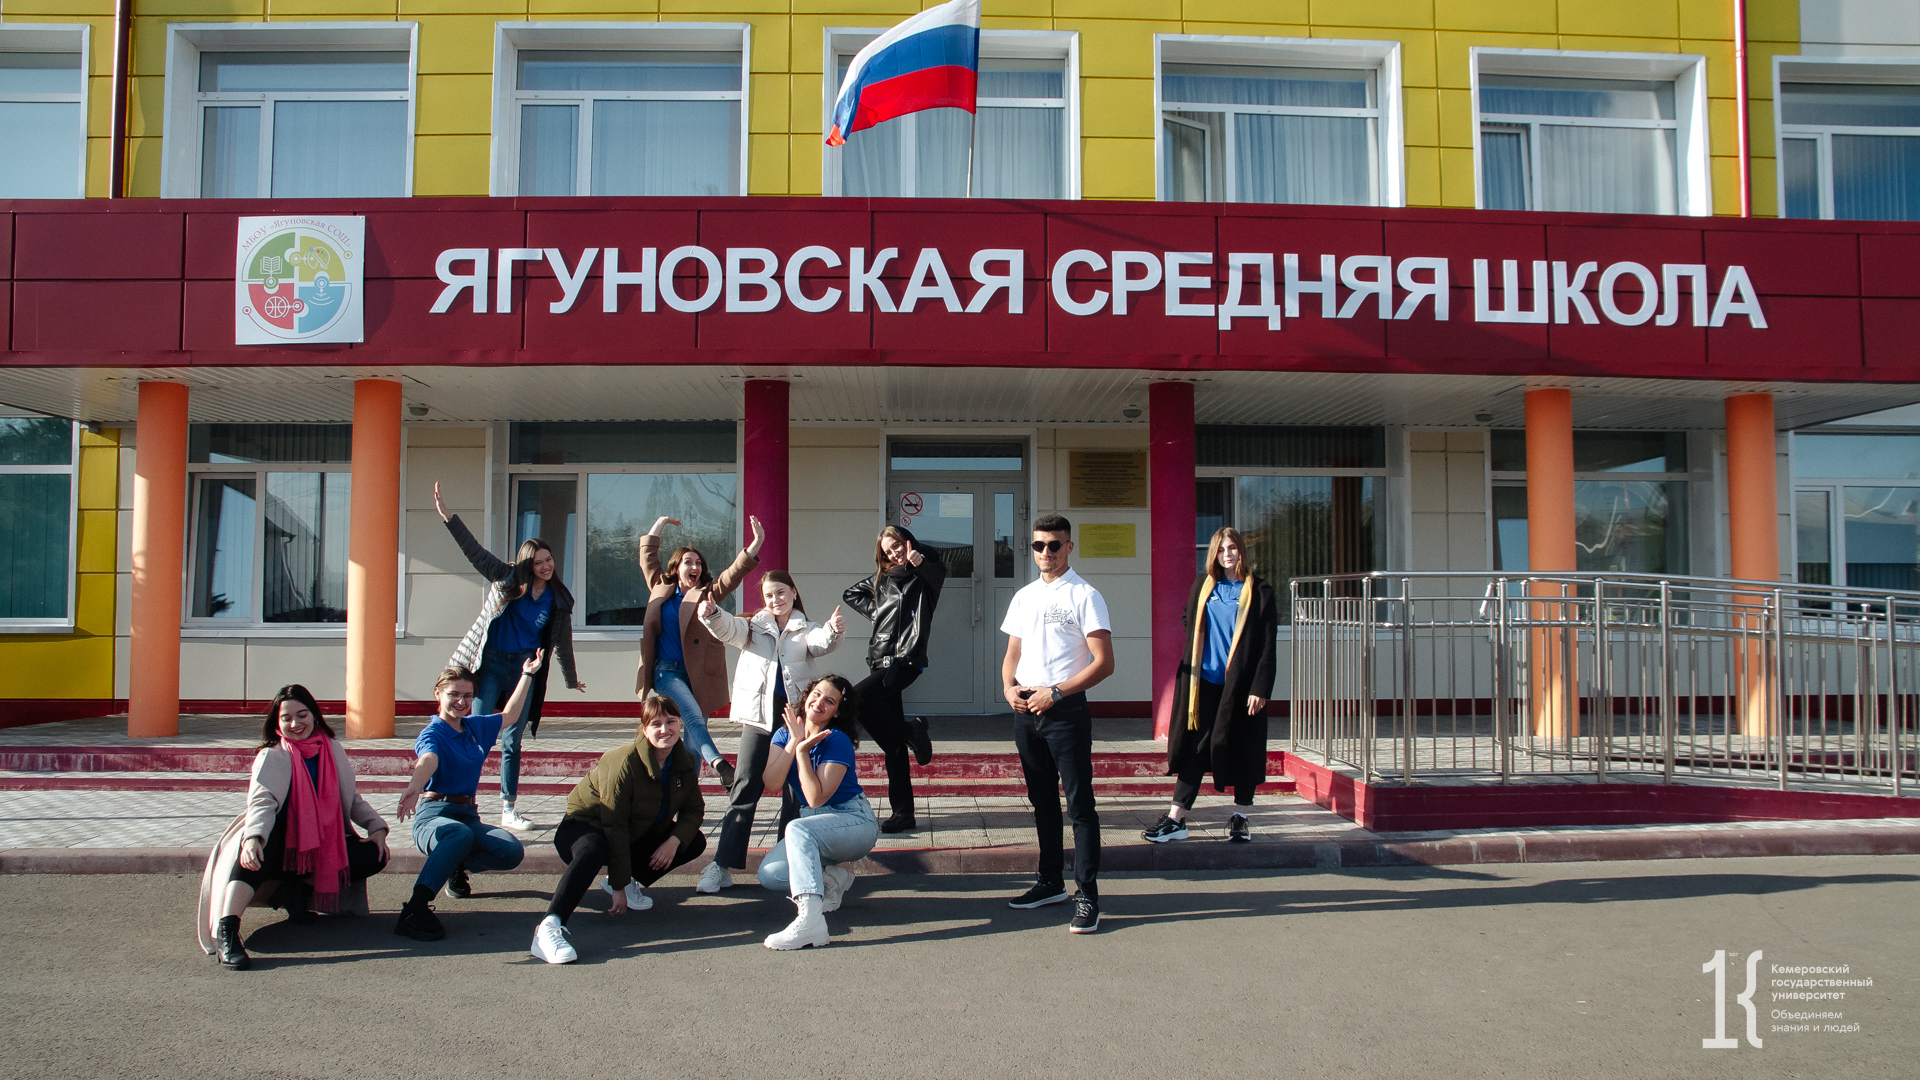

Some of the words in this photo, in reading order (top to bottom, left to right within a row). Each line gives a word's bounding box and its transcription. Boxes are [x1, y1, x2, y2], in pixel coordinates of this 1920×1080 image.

[242, 226, 267, 251] МБОУ
[270, 218, 326, 230] «Ягуновская
[327, 224, 351, 248] СОШ»
[428, 245, 1024, 315] ЯГУНОВСКАЯ
[1051, 249, 1449, 331] СРЕДНЯЯ
[1473, 258, 1769, 330] ШКОЛА
